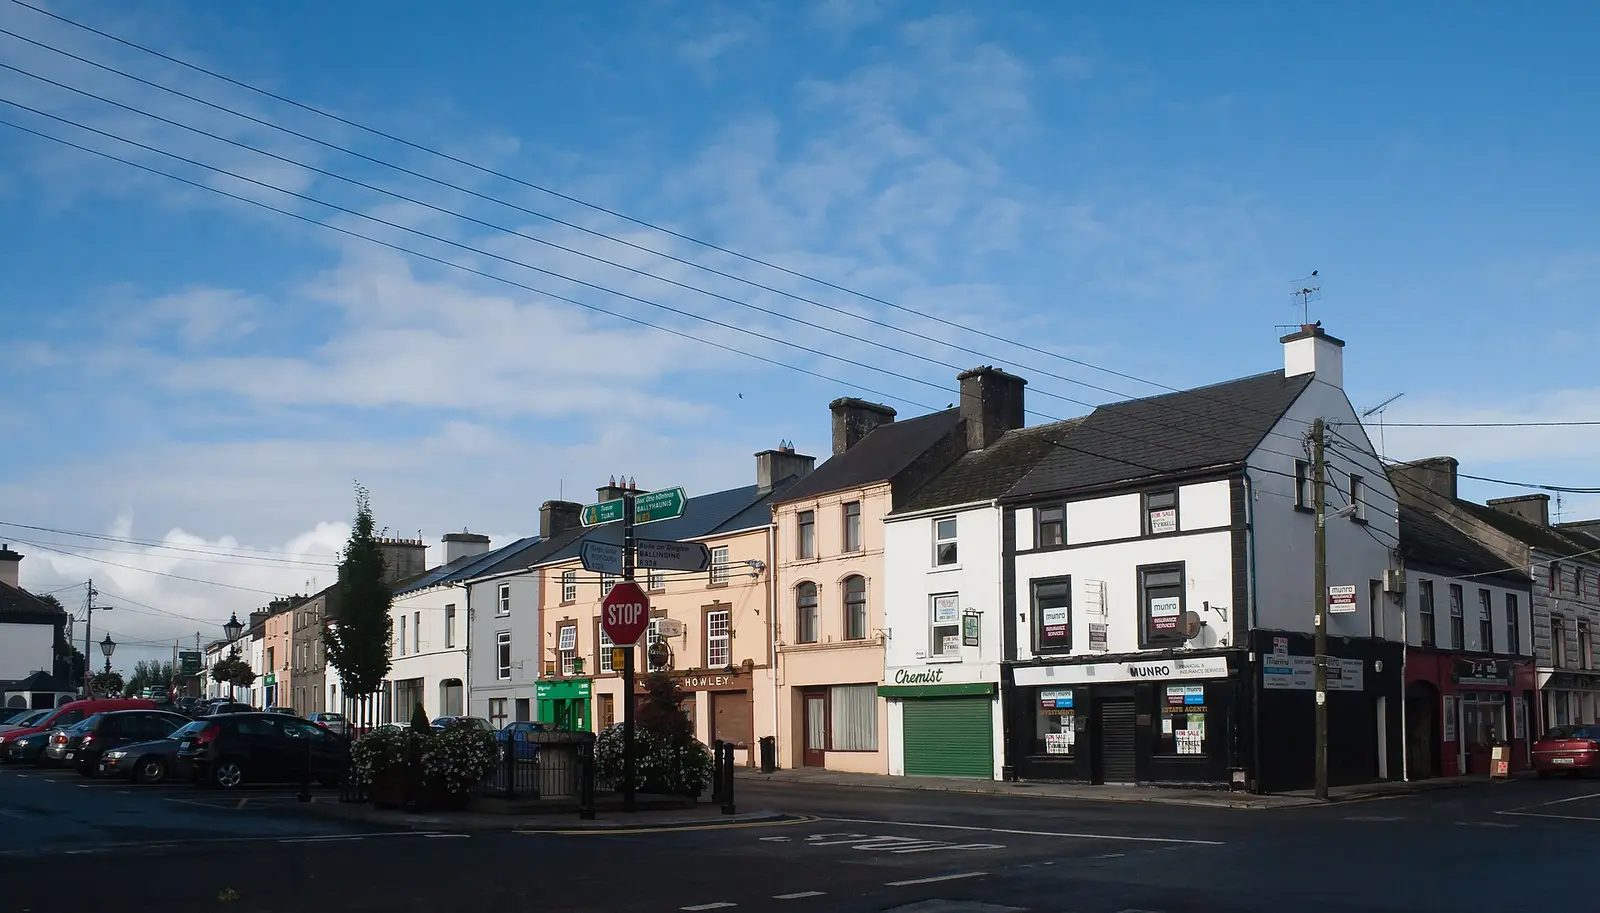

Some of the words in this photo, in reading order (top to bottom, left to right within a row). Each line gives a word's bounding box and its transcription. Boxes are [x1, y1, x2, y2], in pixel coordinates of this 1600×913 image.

[636, 500, 672, 512] BALLYHAUNIS
[639, 551, 681, 560] BALLINDINE
[1154, 603, 1177, 611] munro
[608, 603, 643, 626] STOP
[895, 669, 944, 684] Chemist
[1129, 665, 1170, 677] MUNRO
[804, 833, 1007, 853] STOP
